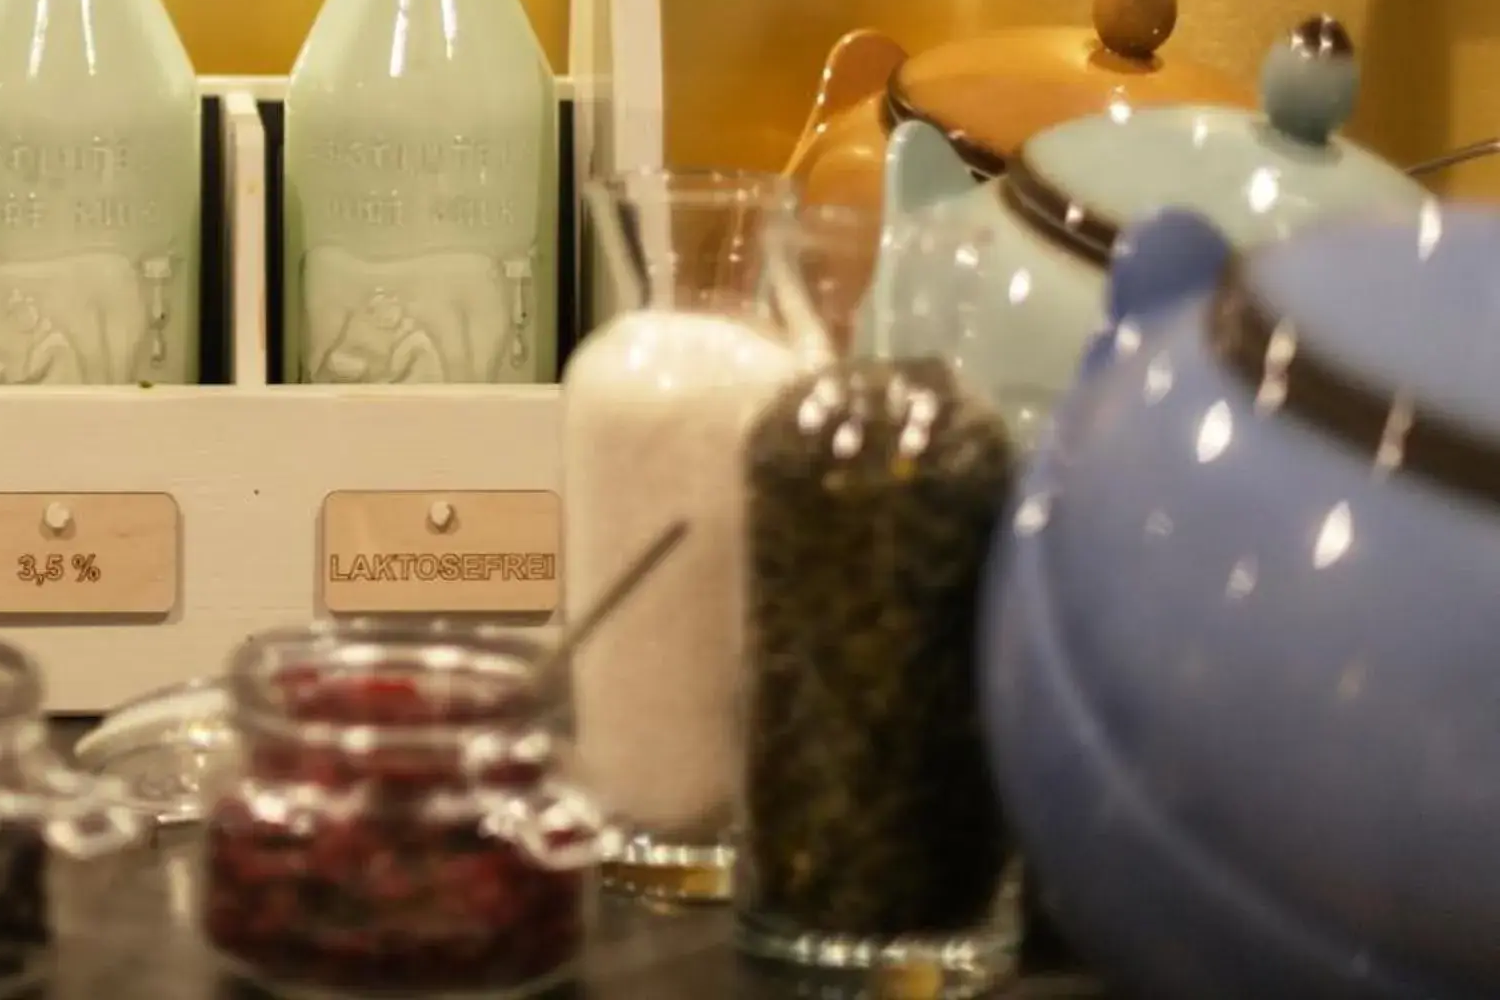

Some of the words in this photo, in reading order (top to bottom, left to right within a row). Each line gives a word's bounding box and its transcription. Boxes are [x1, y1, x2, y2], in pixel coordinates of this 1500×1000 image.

[17, 553, 65, 586] 3,5
[71, 553, 102, 583] %
[329, 552, 556, 582] LAKTOSEFREI
